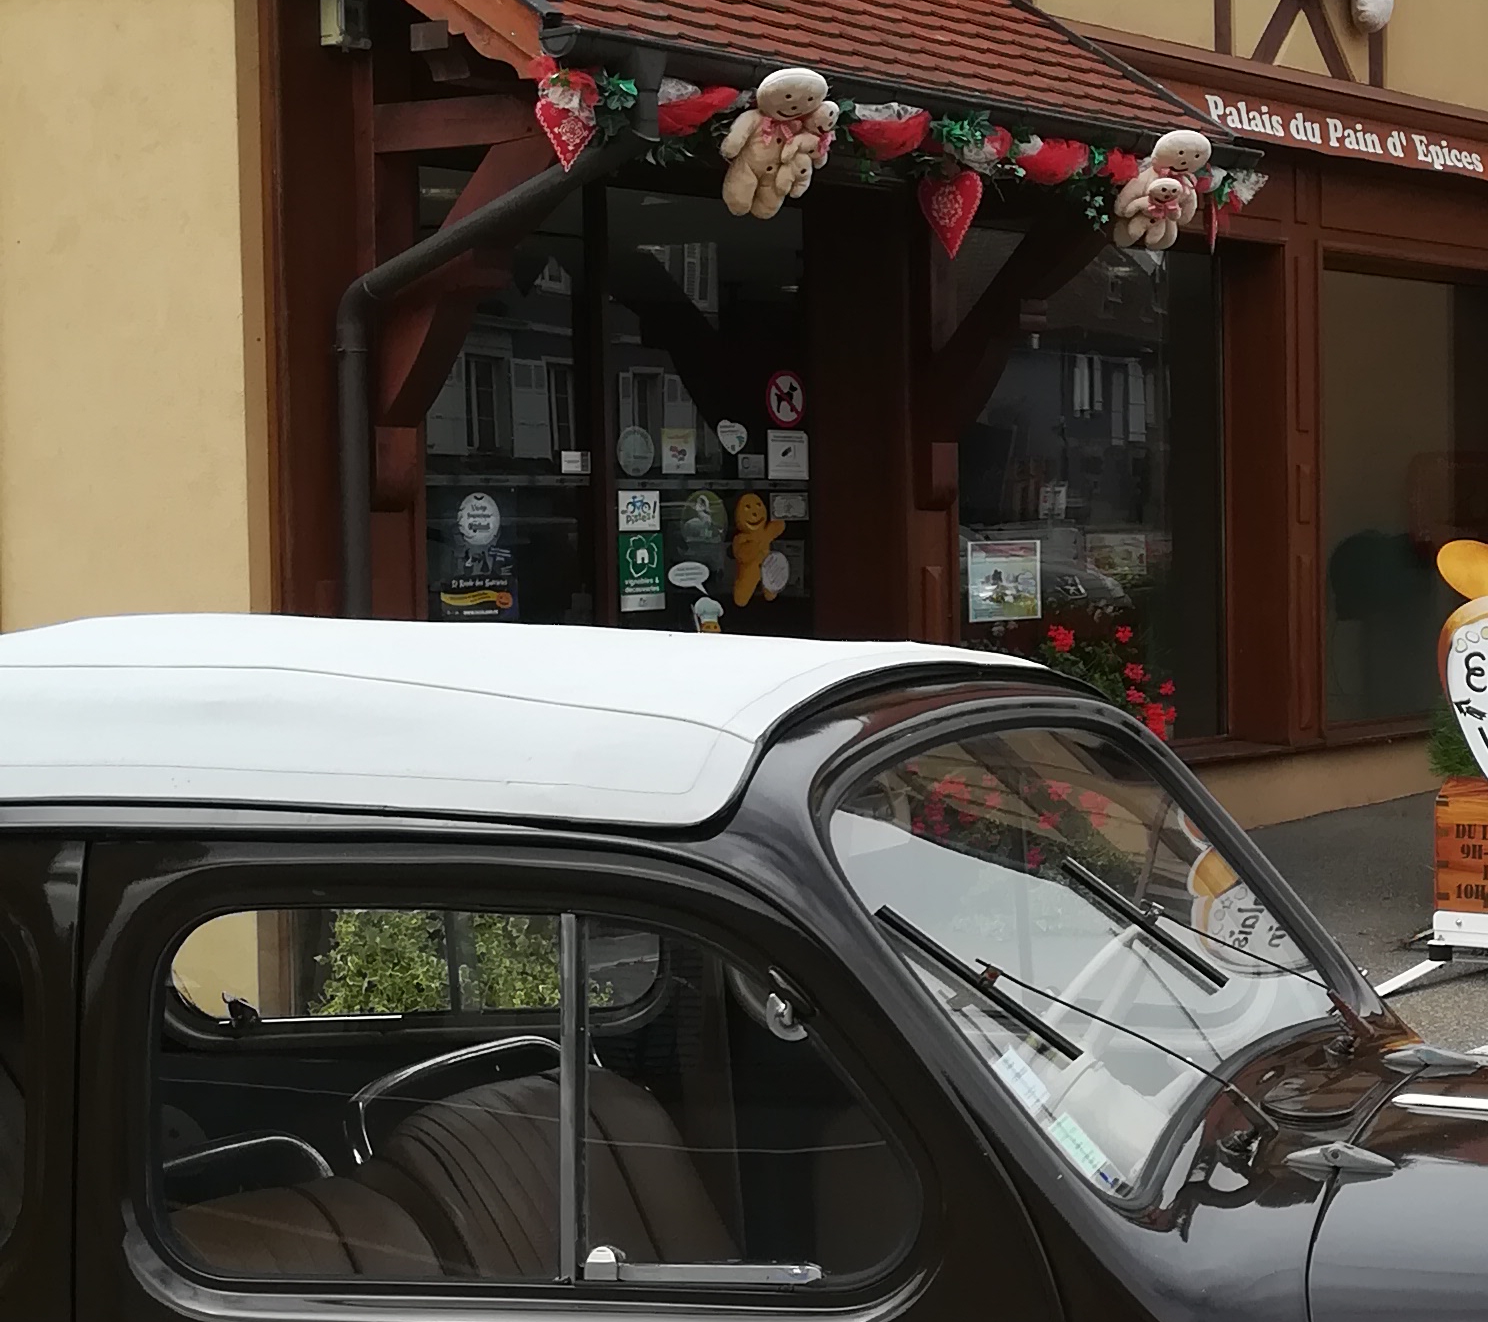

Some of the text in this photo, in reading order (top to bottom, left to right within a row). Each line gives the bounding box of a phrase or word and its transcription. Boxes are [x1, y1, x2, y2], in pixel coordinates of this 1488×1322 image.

[1204, 94, 1285, 138] Palais
[1289, 112, 1323, 145] du
[1325, 117, 1384, 155] Pain
[1412, 134, 1485, 174] Epices
[1455, 823, 1478, 840] DU
